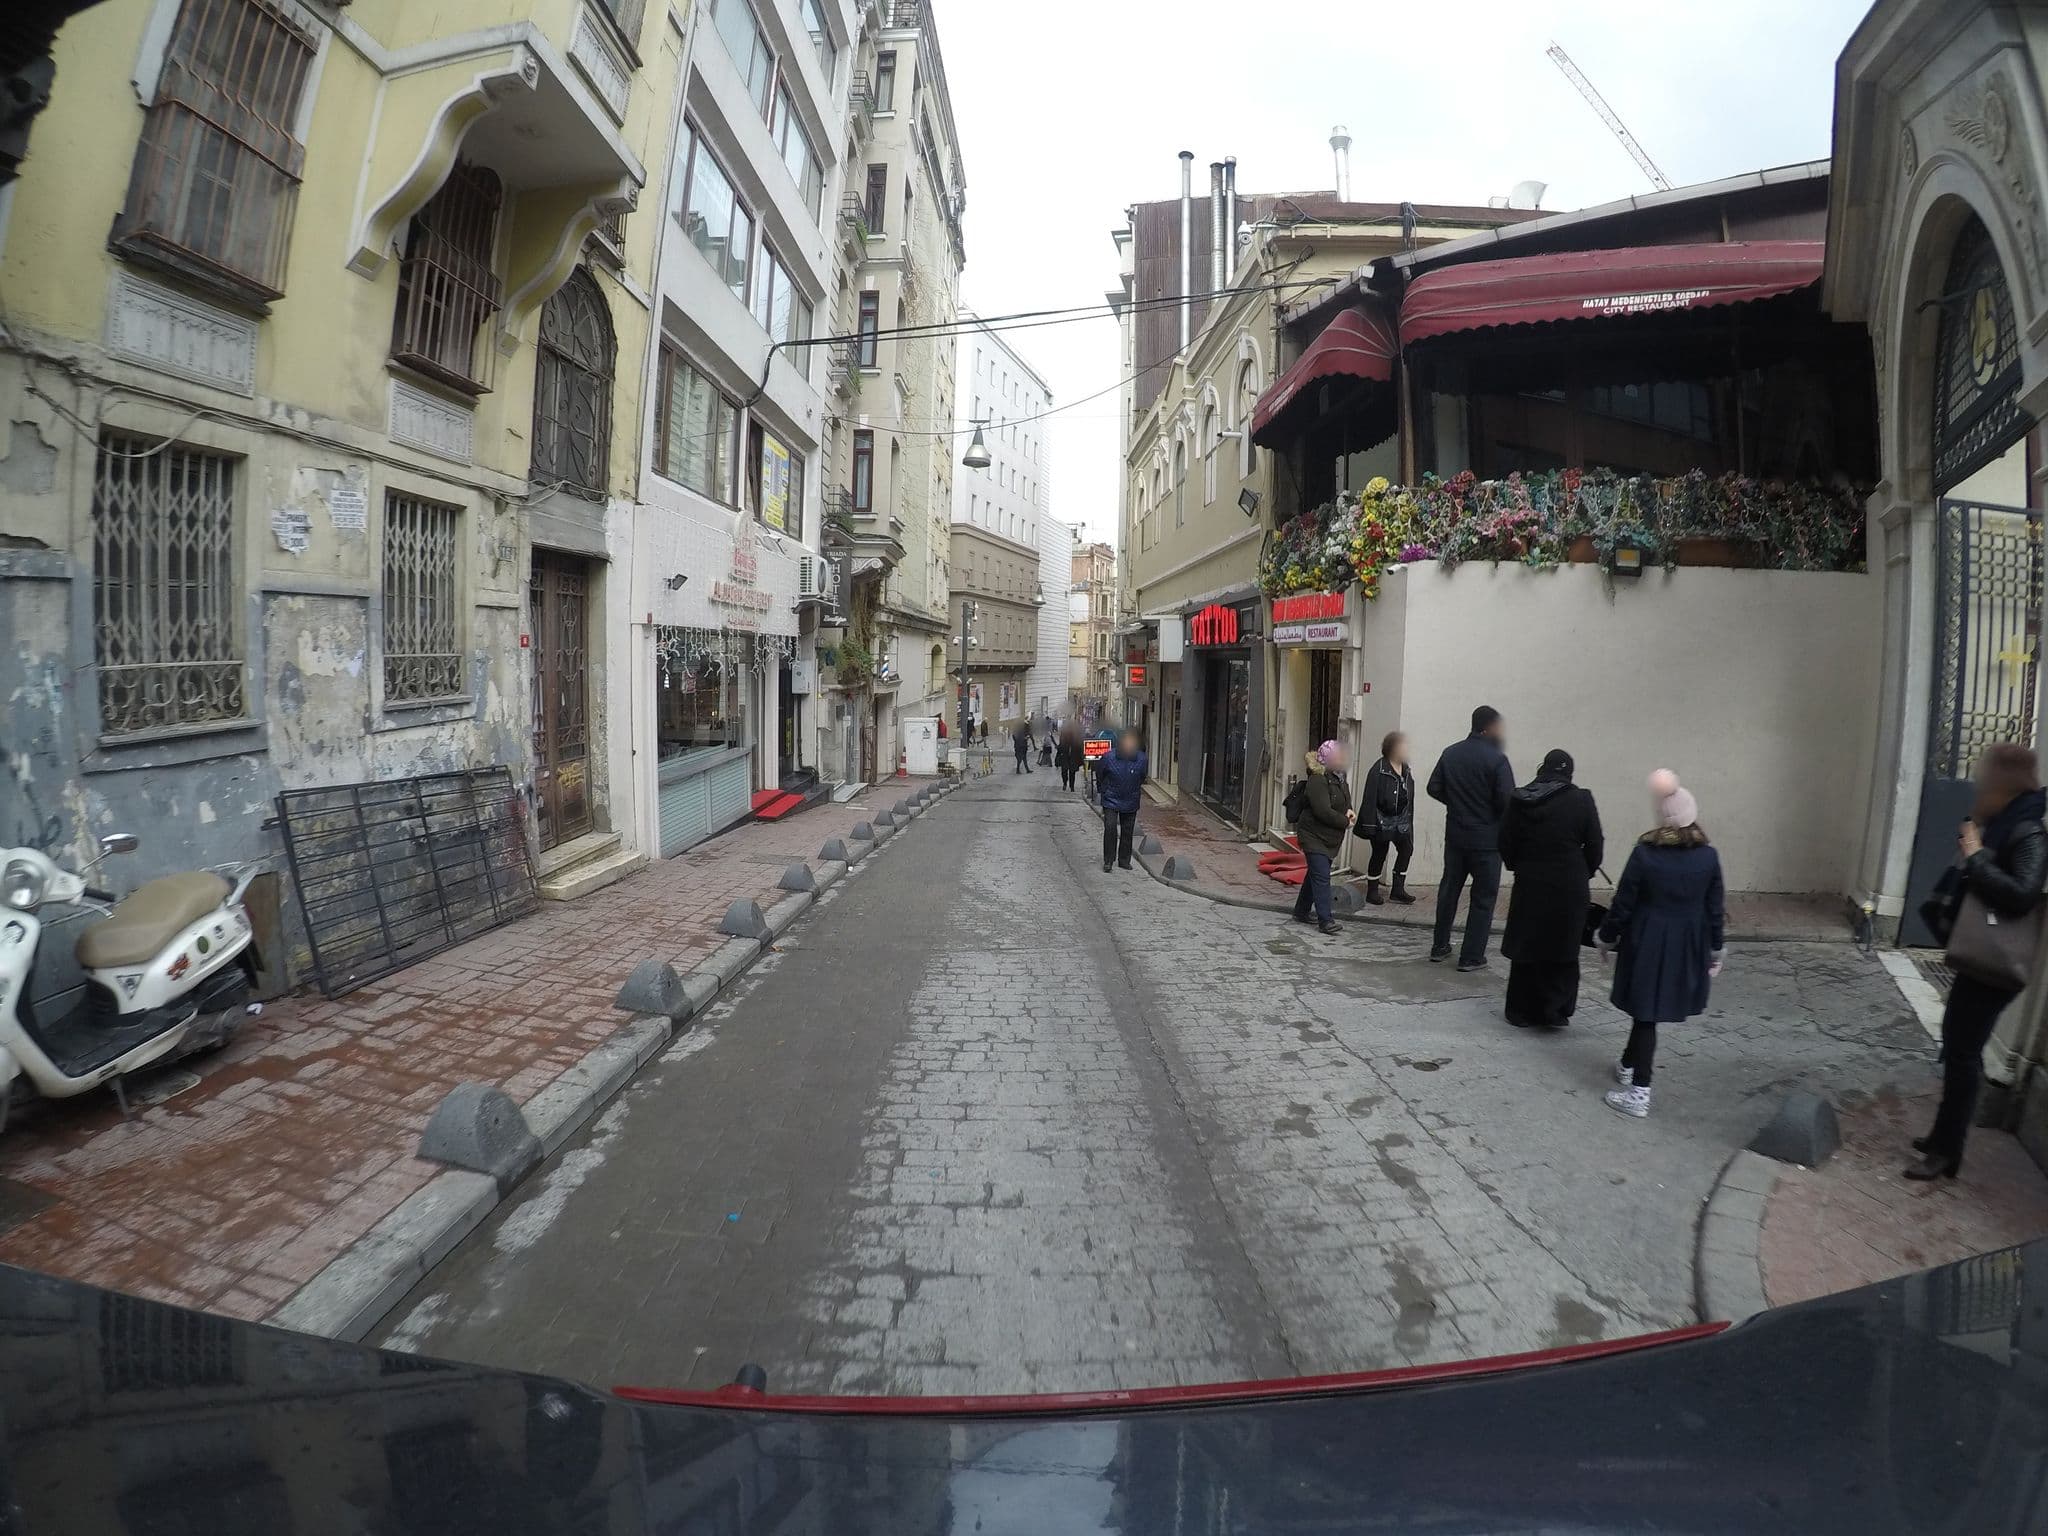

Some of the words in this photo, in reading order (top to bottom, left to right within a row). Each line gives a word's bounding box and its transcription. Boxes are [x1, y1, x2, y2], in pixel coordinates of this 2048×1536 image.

[1582, 298, 1609, 308] HATAY
[1603, 305, 1624, 314] CITY
[1627, 299, 1690, 312] RESTAURANT
[831, 563, 841, 615] HOTEL
[1190, 604, 1238, 646] TATTOO
[1307, 626, 1339, 640] RESTAURANT
